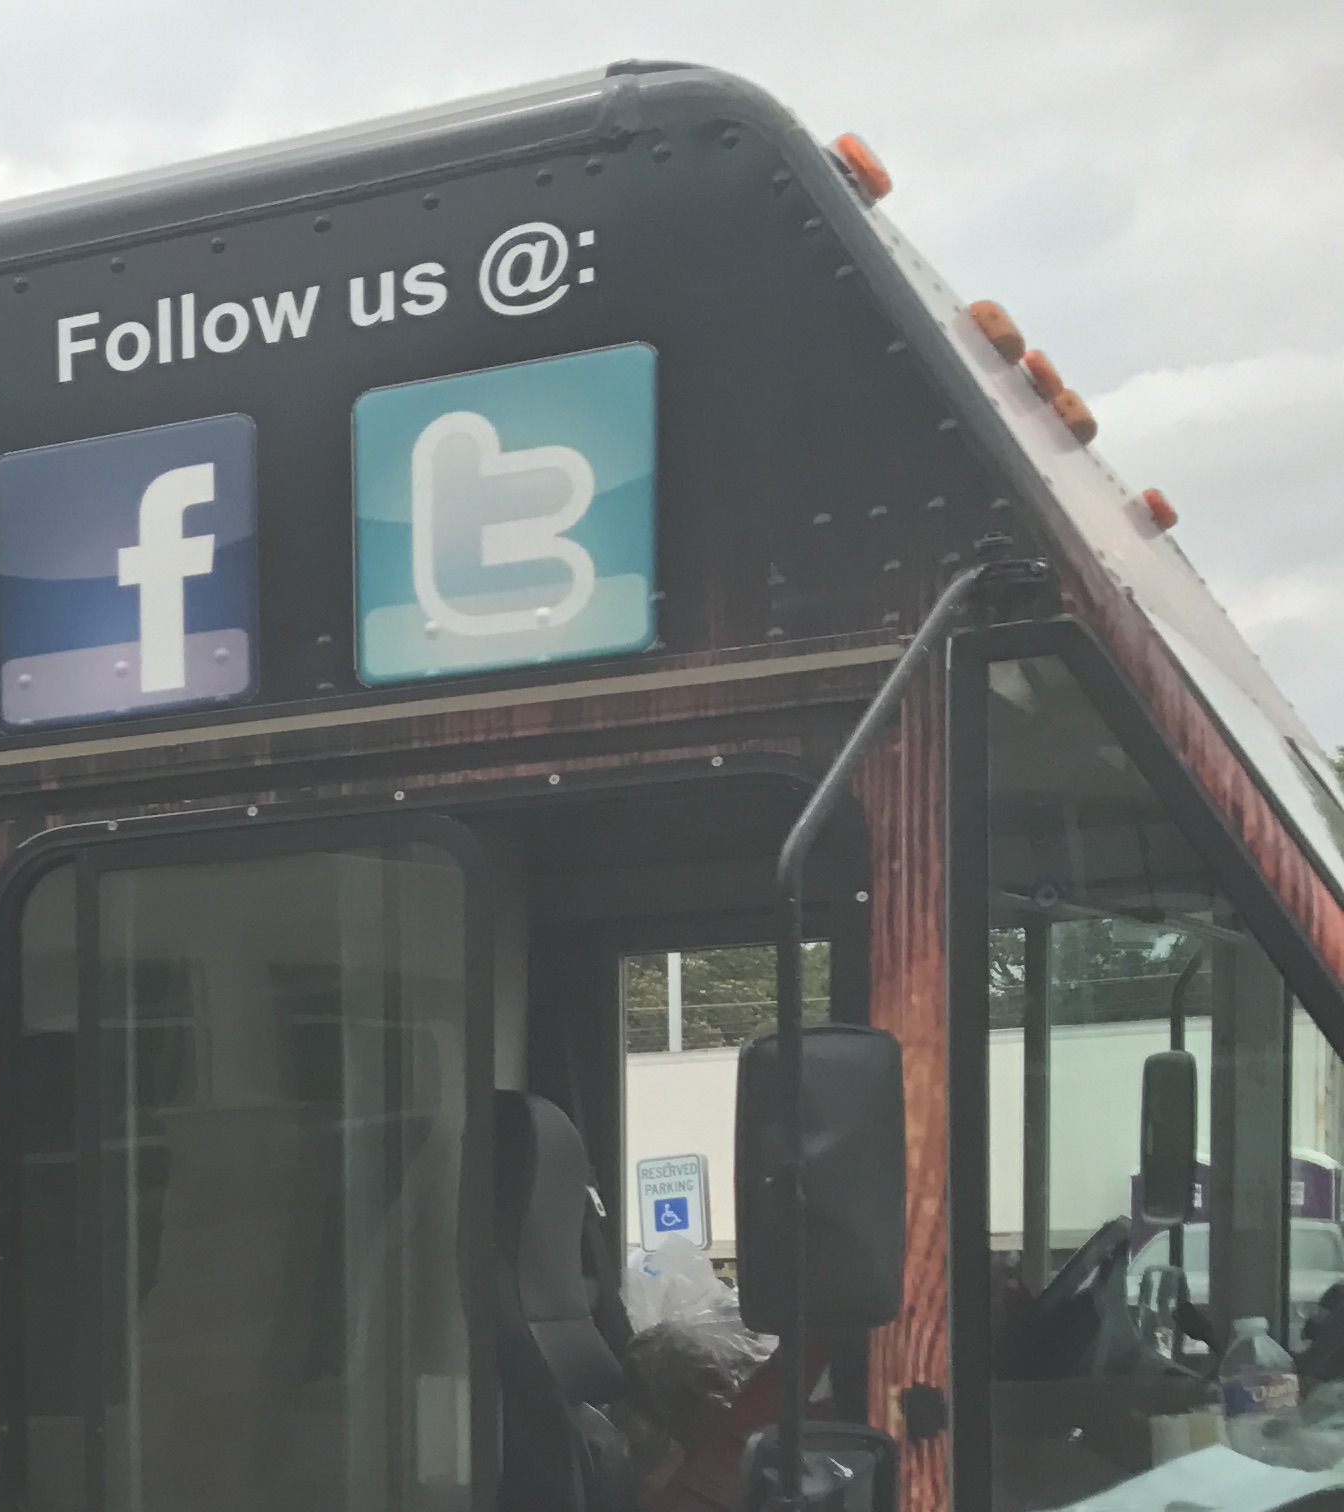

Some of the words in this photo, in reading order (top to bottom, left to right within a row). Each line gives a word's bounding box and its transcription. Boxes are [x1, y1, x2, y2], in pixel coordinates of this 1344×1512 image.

[56, 284, 321, 383] Follow
[349, 259, 449, 327] us
[479, 221, 597, 317] @:
[641, 1162, 698, 1180] RESERVED
[644, 1180, 694, 1196] PARKING
